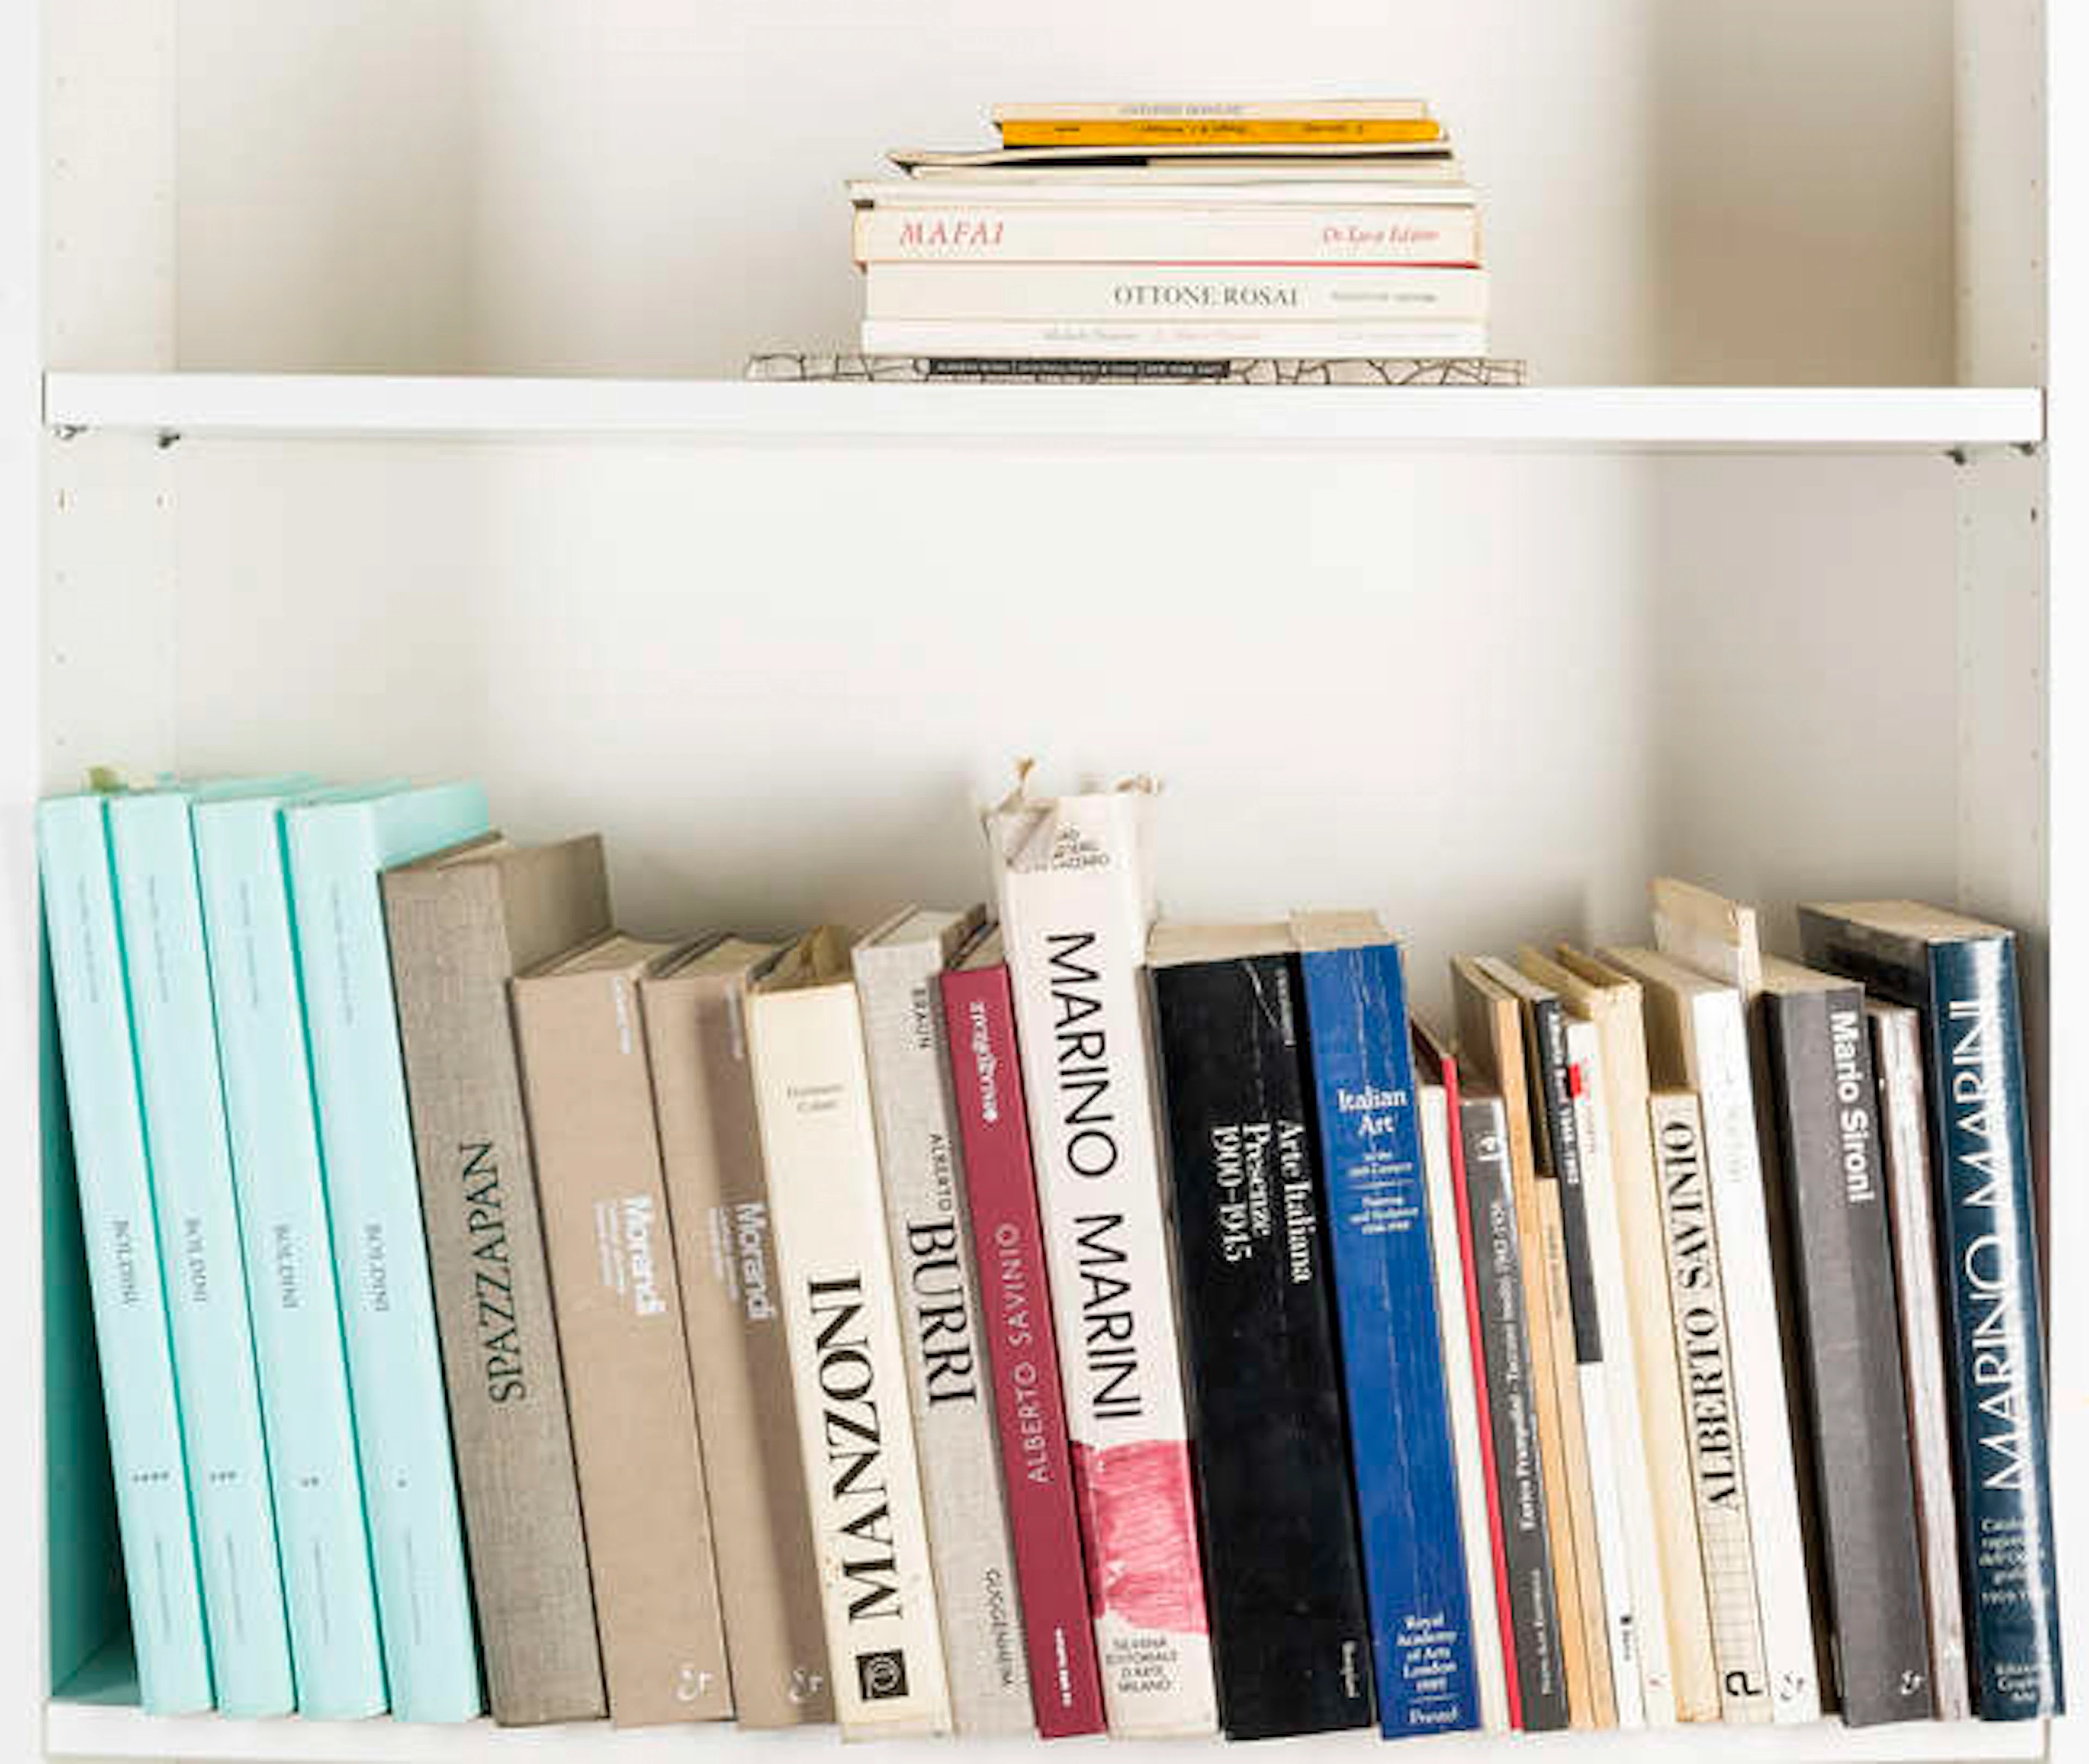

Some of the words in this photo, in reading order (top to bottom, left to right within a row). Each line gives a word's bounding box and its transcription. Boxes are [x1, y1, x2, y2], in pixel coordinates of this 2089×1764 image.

[899, 221, 1004, 246] MAFAI
[1114, 286, 1221, 307] OTTONE
[1223, 286, 1298, 307] ROSAI
[1046, 932, 1118, 1177] MARINO
[1338, 1084, 1408, 1112] Italian
[1830, 1010, 1863, 1103] Mario
[1948, 1000, 2012, 1208] MARINI
[929, 1132, 952, 1212] ALBERTO
[1243, 1122, 1272, 1236] Presenze
[1276, 1119, 1305, 1178] Arte
[1358, 1115, 1394, 1136] Art
[1840, 1109, 1875, 1203] Sironi
[624, 1194, 667, 1316] Morandi
[737, 1202, 776, 1321] Morandi
[1284, 1180, 1317, 1284] Italiana
[1660, 1121, 1713, 1291] SAVINIO
[460, 1141, 526, 1404] SPAZZAPAN
[908, 1217, 978, 1407] BURRI
[994, 1222, 1035, 1347] SAVINIO
[1074, 1213, 1142, 1420] MARINI
[1011, 1360, 1050, 1484] ALBERTO
[1684, 1307, 1736, 1512] ALBERTO
[1965, 1234, 2033, 1491] MARINO
[808, 1277, 904, 1623] MANZONI
